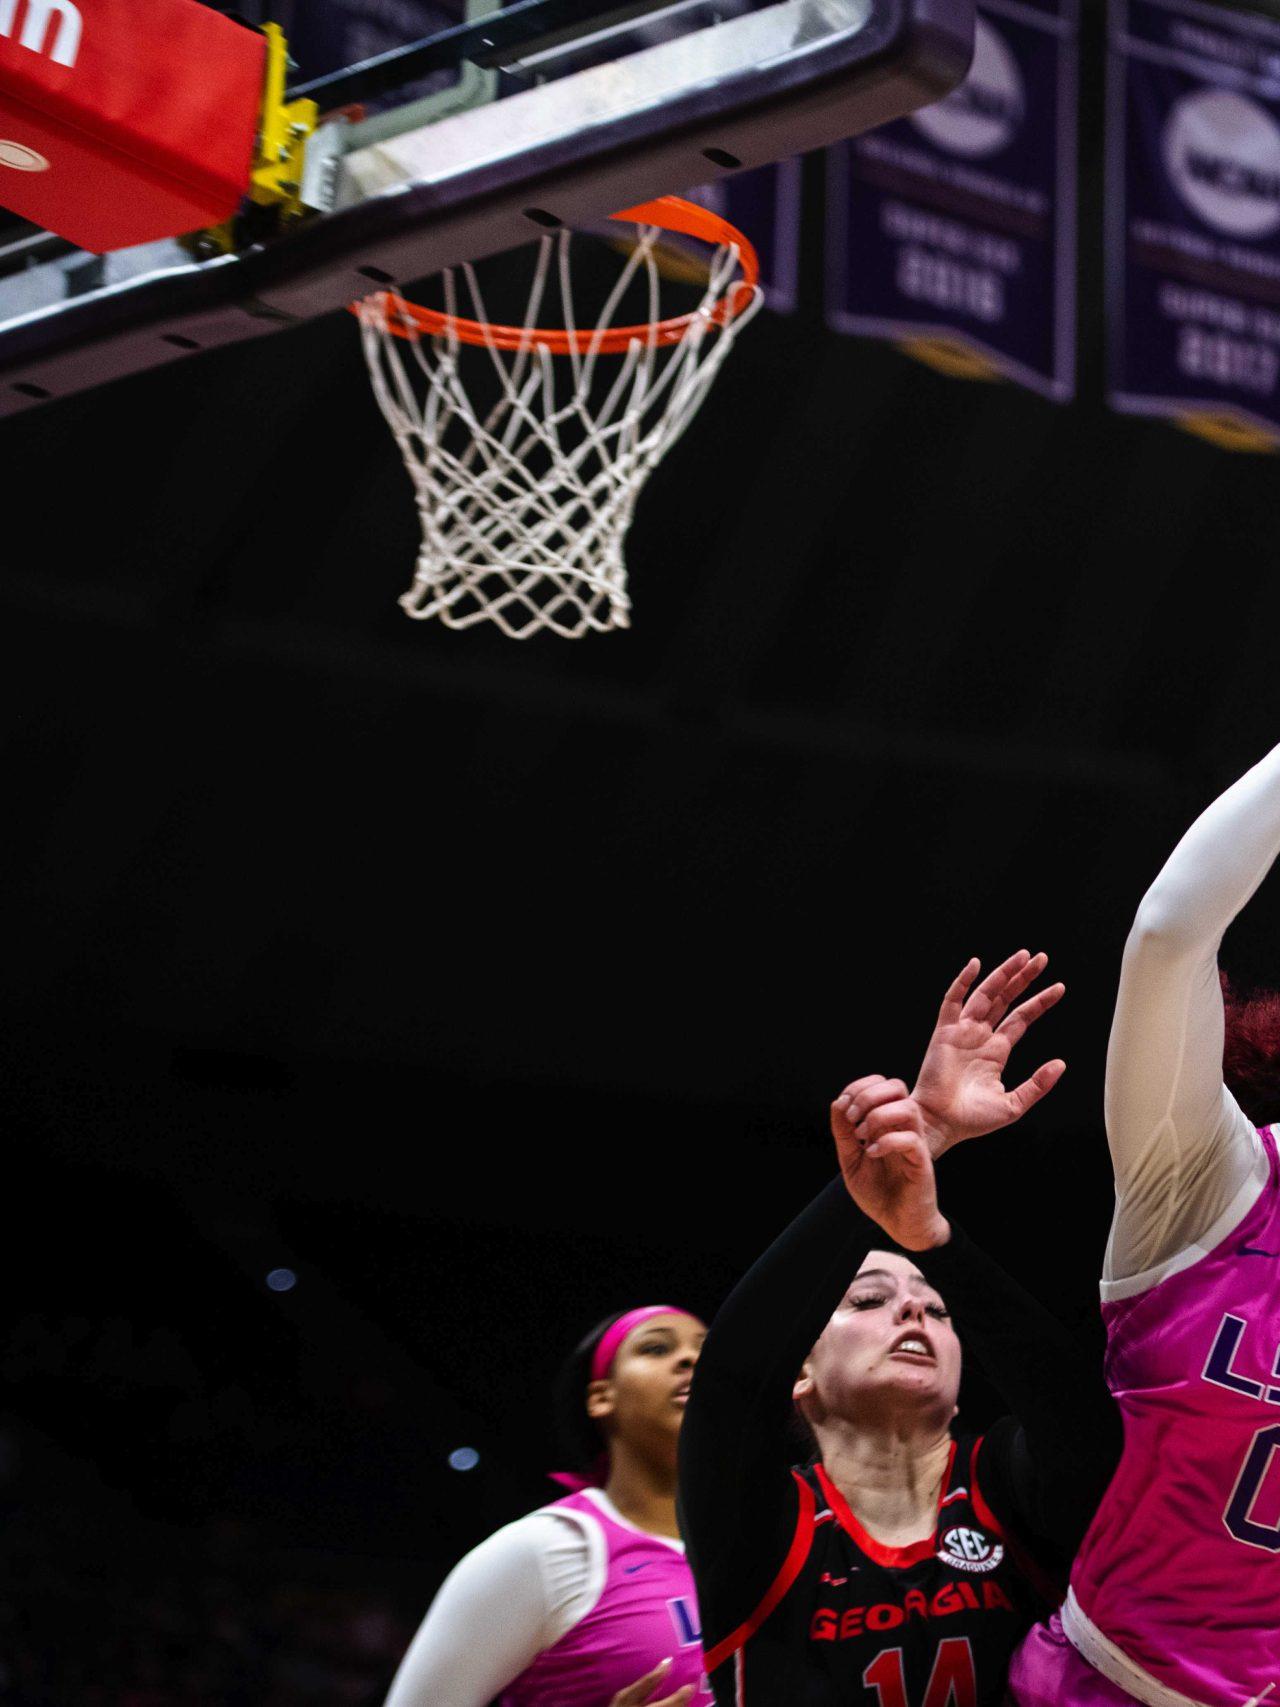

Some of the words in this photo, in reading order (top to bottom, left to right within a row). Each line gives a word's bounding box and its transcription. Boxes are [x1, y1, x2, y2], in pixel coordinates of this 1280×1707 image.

[944, 1527, 990, 1562] SEC
[808, 1580, 1016, 1642] GEORGIA
[862, 1636, 978, 1707] 14
